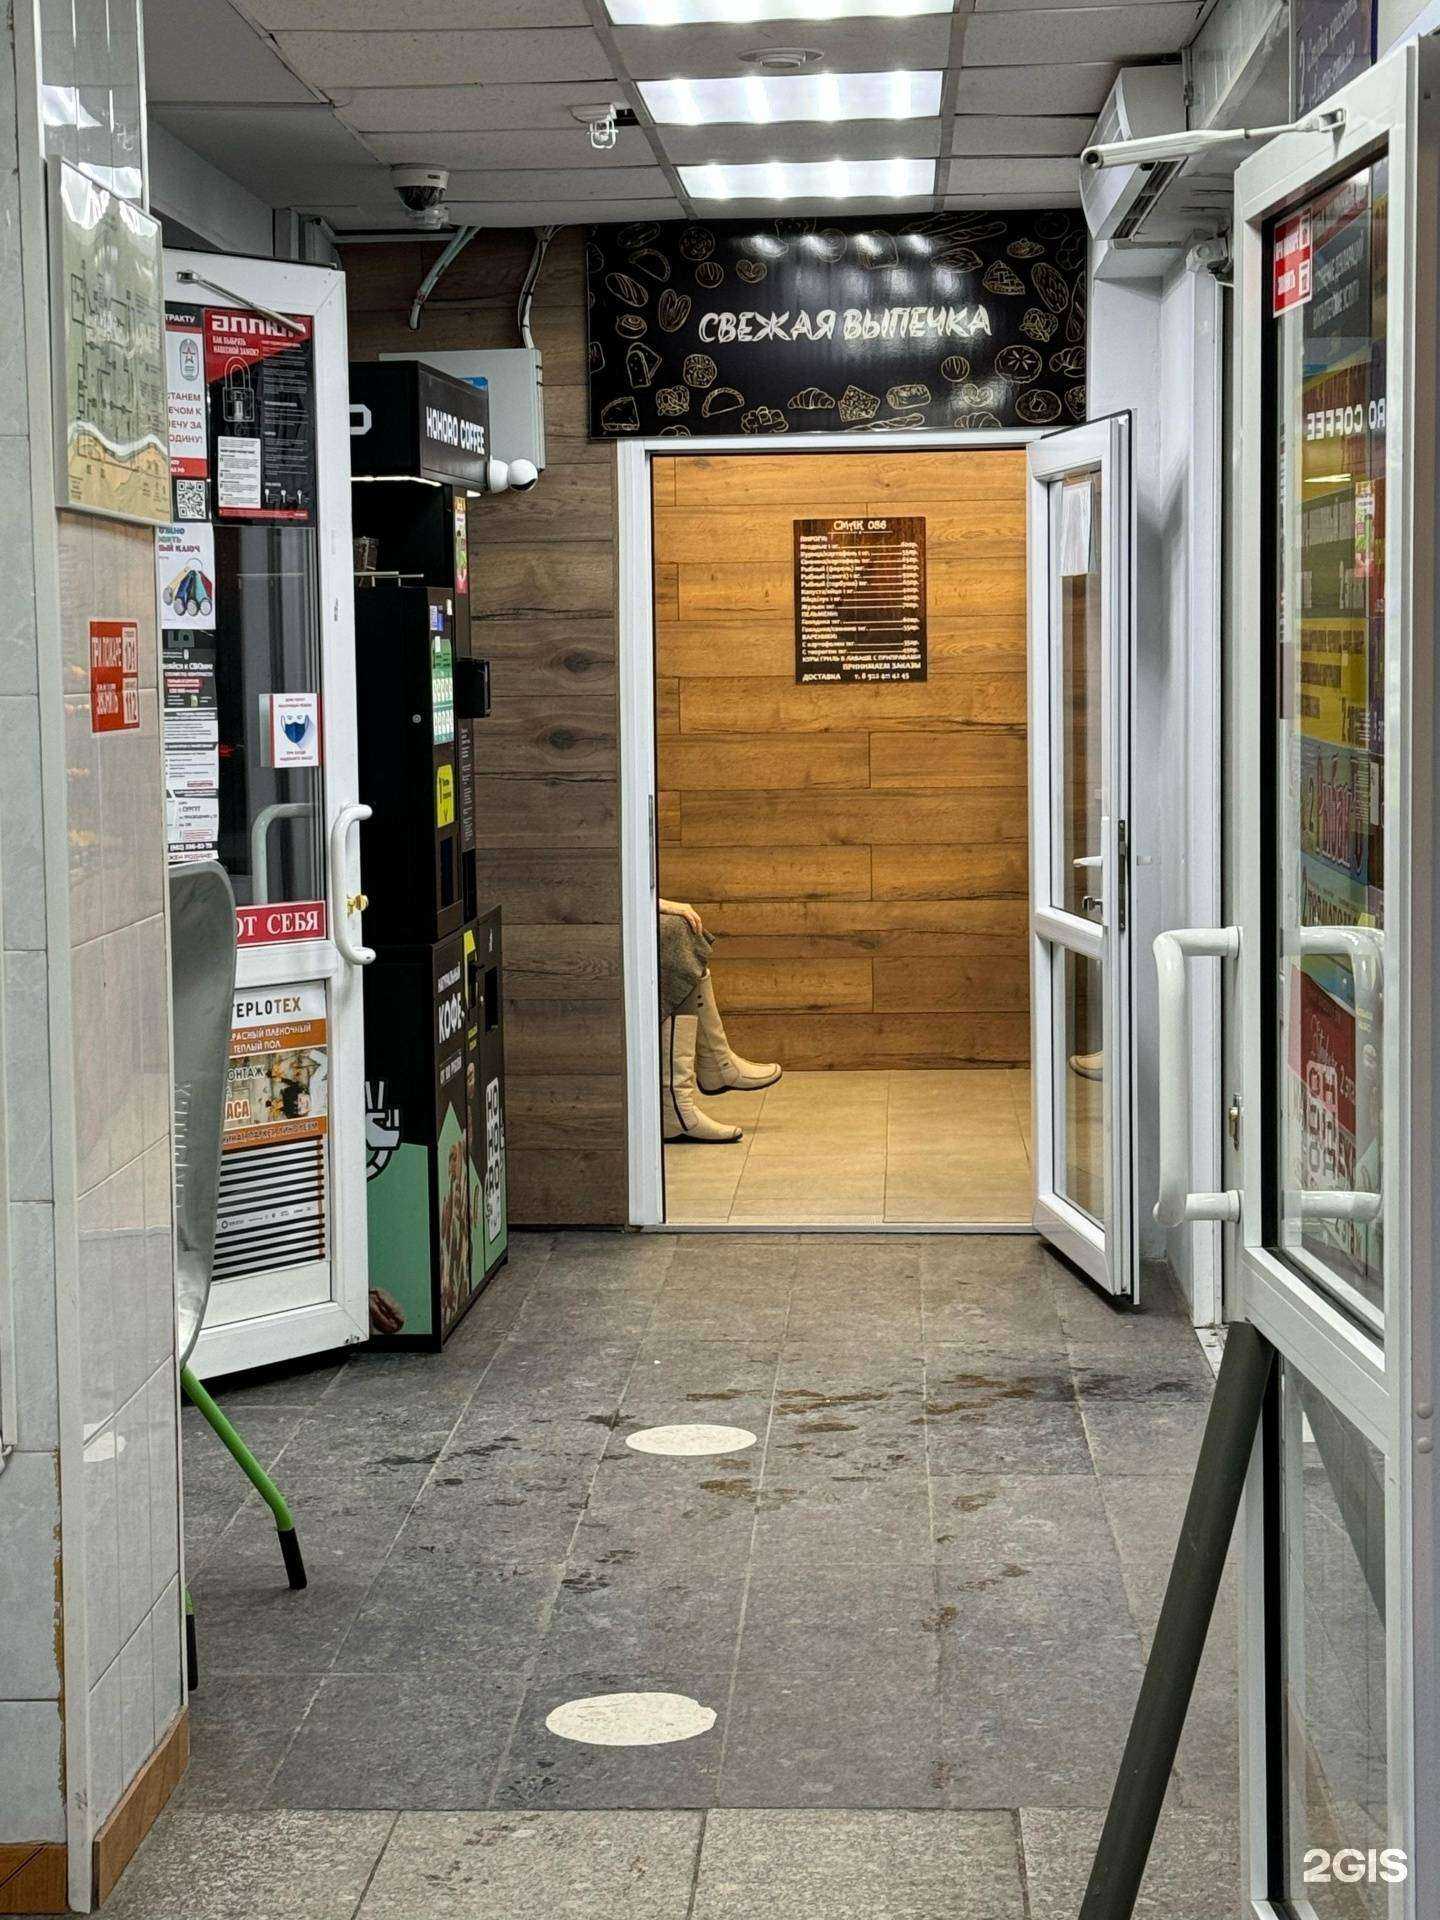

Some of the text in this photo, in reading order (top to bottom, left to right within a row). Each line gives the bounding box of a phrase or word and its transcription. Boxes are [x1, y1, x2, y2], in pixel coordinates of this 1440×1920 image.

[699, 305, 993, 343] СВЕЖАЯ ВЫПЕЧКА
[460, 418, 485, 455] COFFEE
[802, 672, 842, 682] ДОСТАВКА
[266, 911, 319, 935] СЕБЯ
[232, 996, 302, 1019] EPLOTEX
[264, 1039, 281, 1050] ПОЛ
